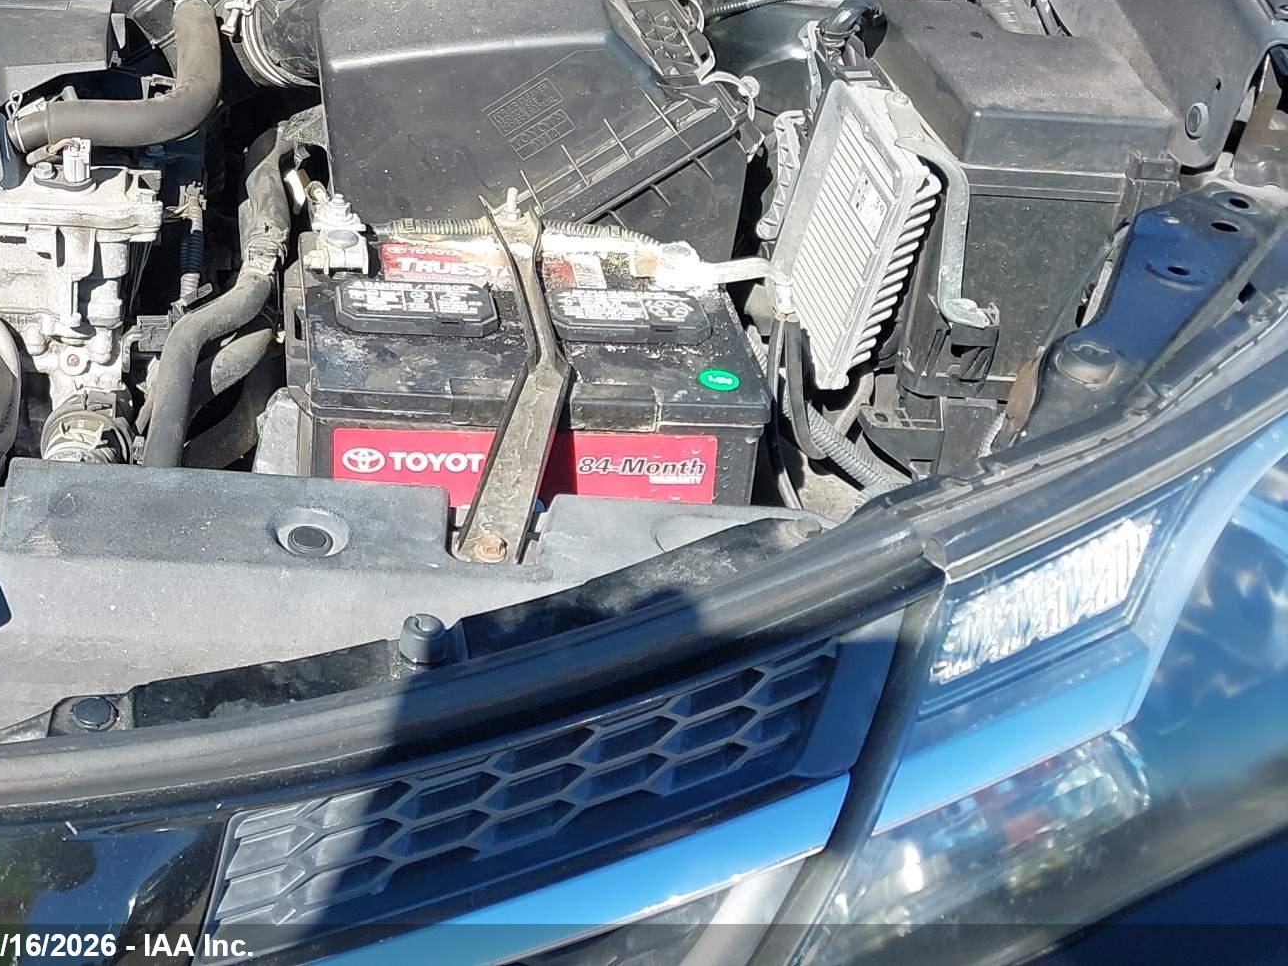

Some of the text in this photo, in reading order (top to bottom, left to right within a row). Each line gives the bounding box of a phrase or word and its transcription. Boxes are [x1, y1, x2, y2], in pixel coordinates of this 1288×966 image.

[397, 257, 513, 278] TRUESTA
[389, 451, 485, 473] TOYOT
[577, 456, 706, 475] 84-Month
